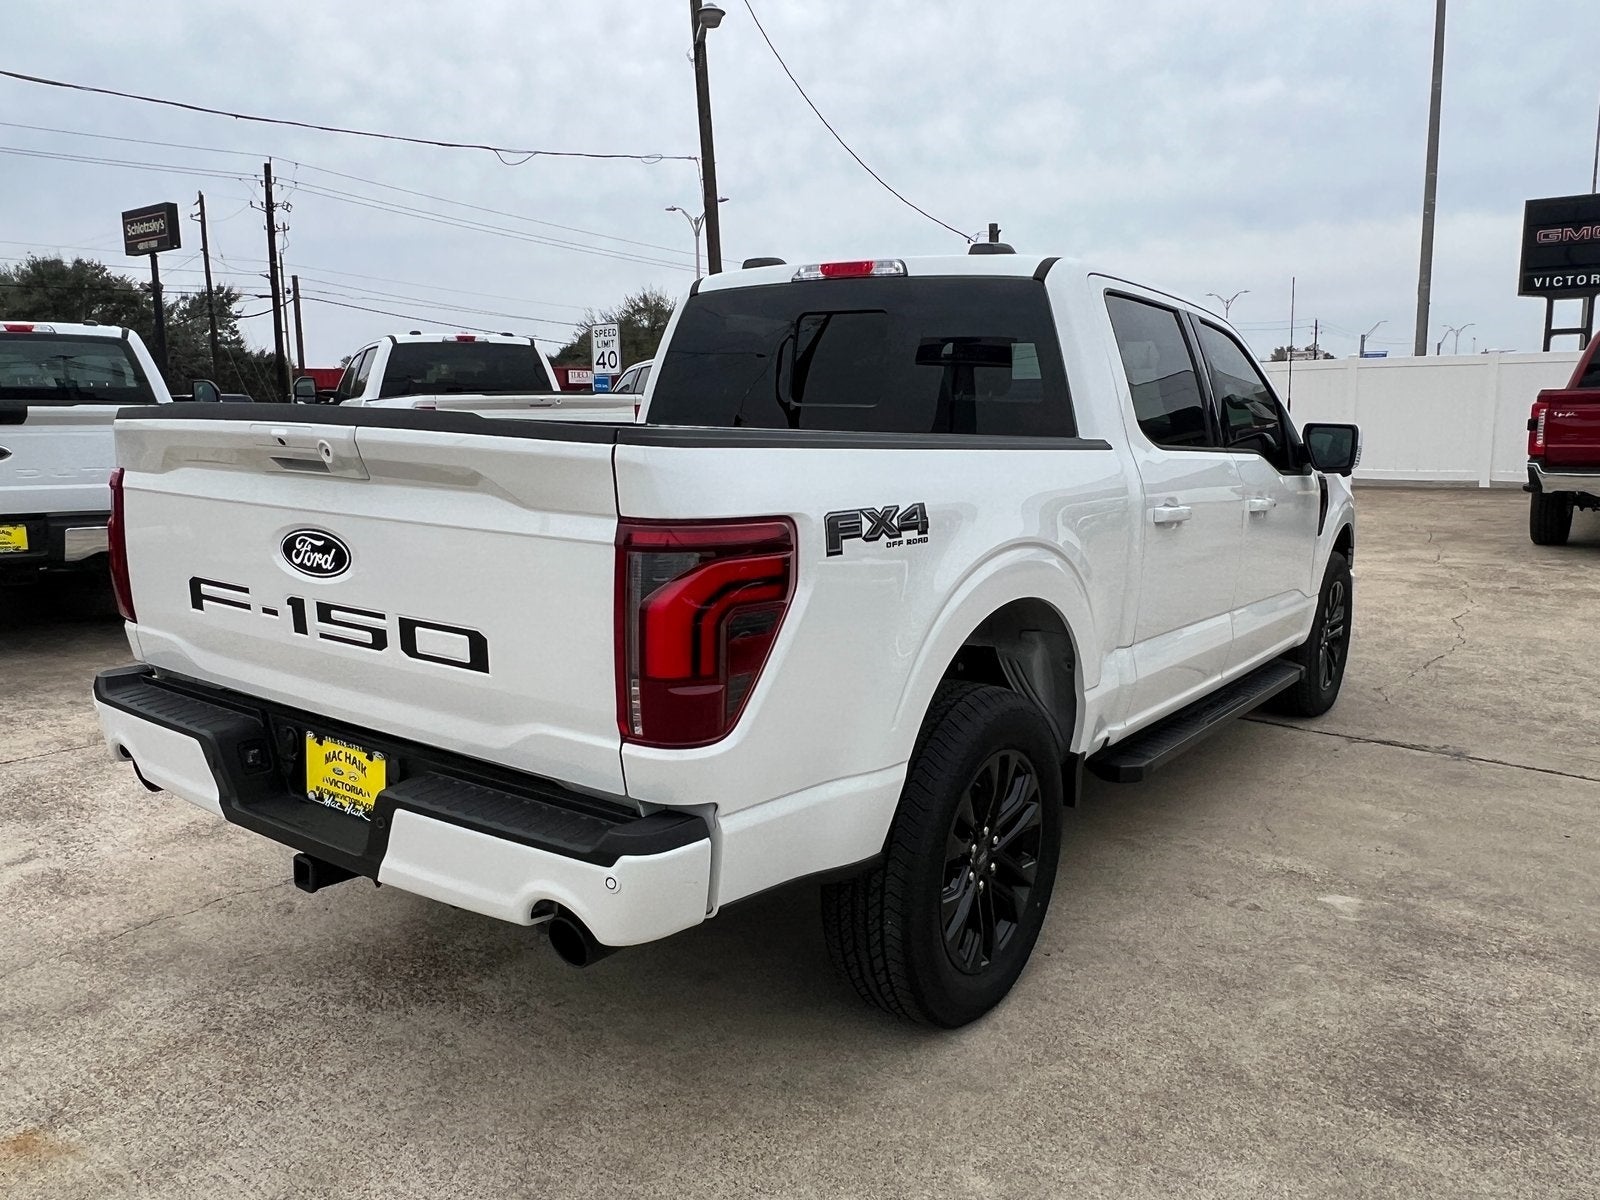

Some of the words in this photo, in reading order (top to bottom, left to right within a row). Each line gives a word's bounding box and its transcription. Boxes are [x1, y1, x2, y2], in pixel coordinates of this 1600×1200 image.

[594, 328, 617, 338] SPEED
[597, 340, 615, 349] LIMIT
[595, 350, 618, 369] 40
[824, 502, 929, 557] FX4
[886, 539, 904, 549] OFF
[906, 536, 929, 546] ROAD
[292, 535, 336, 571] Ford
[188, 576, 491, 675] F-150
[325, 750, 343, 765] MAC
[344, 751, 367, 778] HAIK
[329, 777, 365, 797] VICTORIA
[323, 796, 343, 811] Mac
